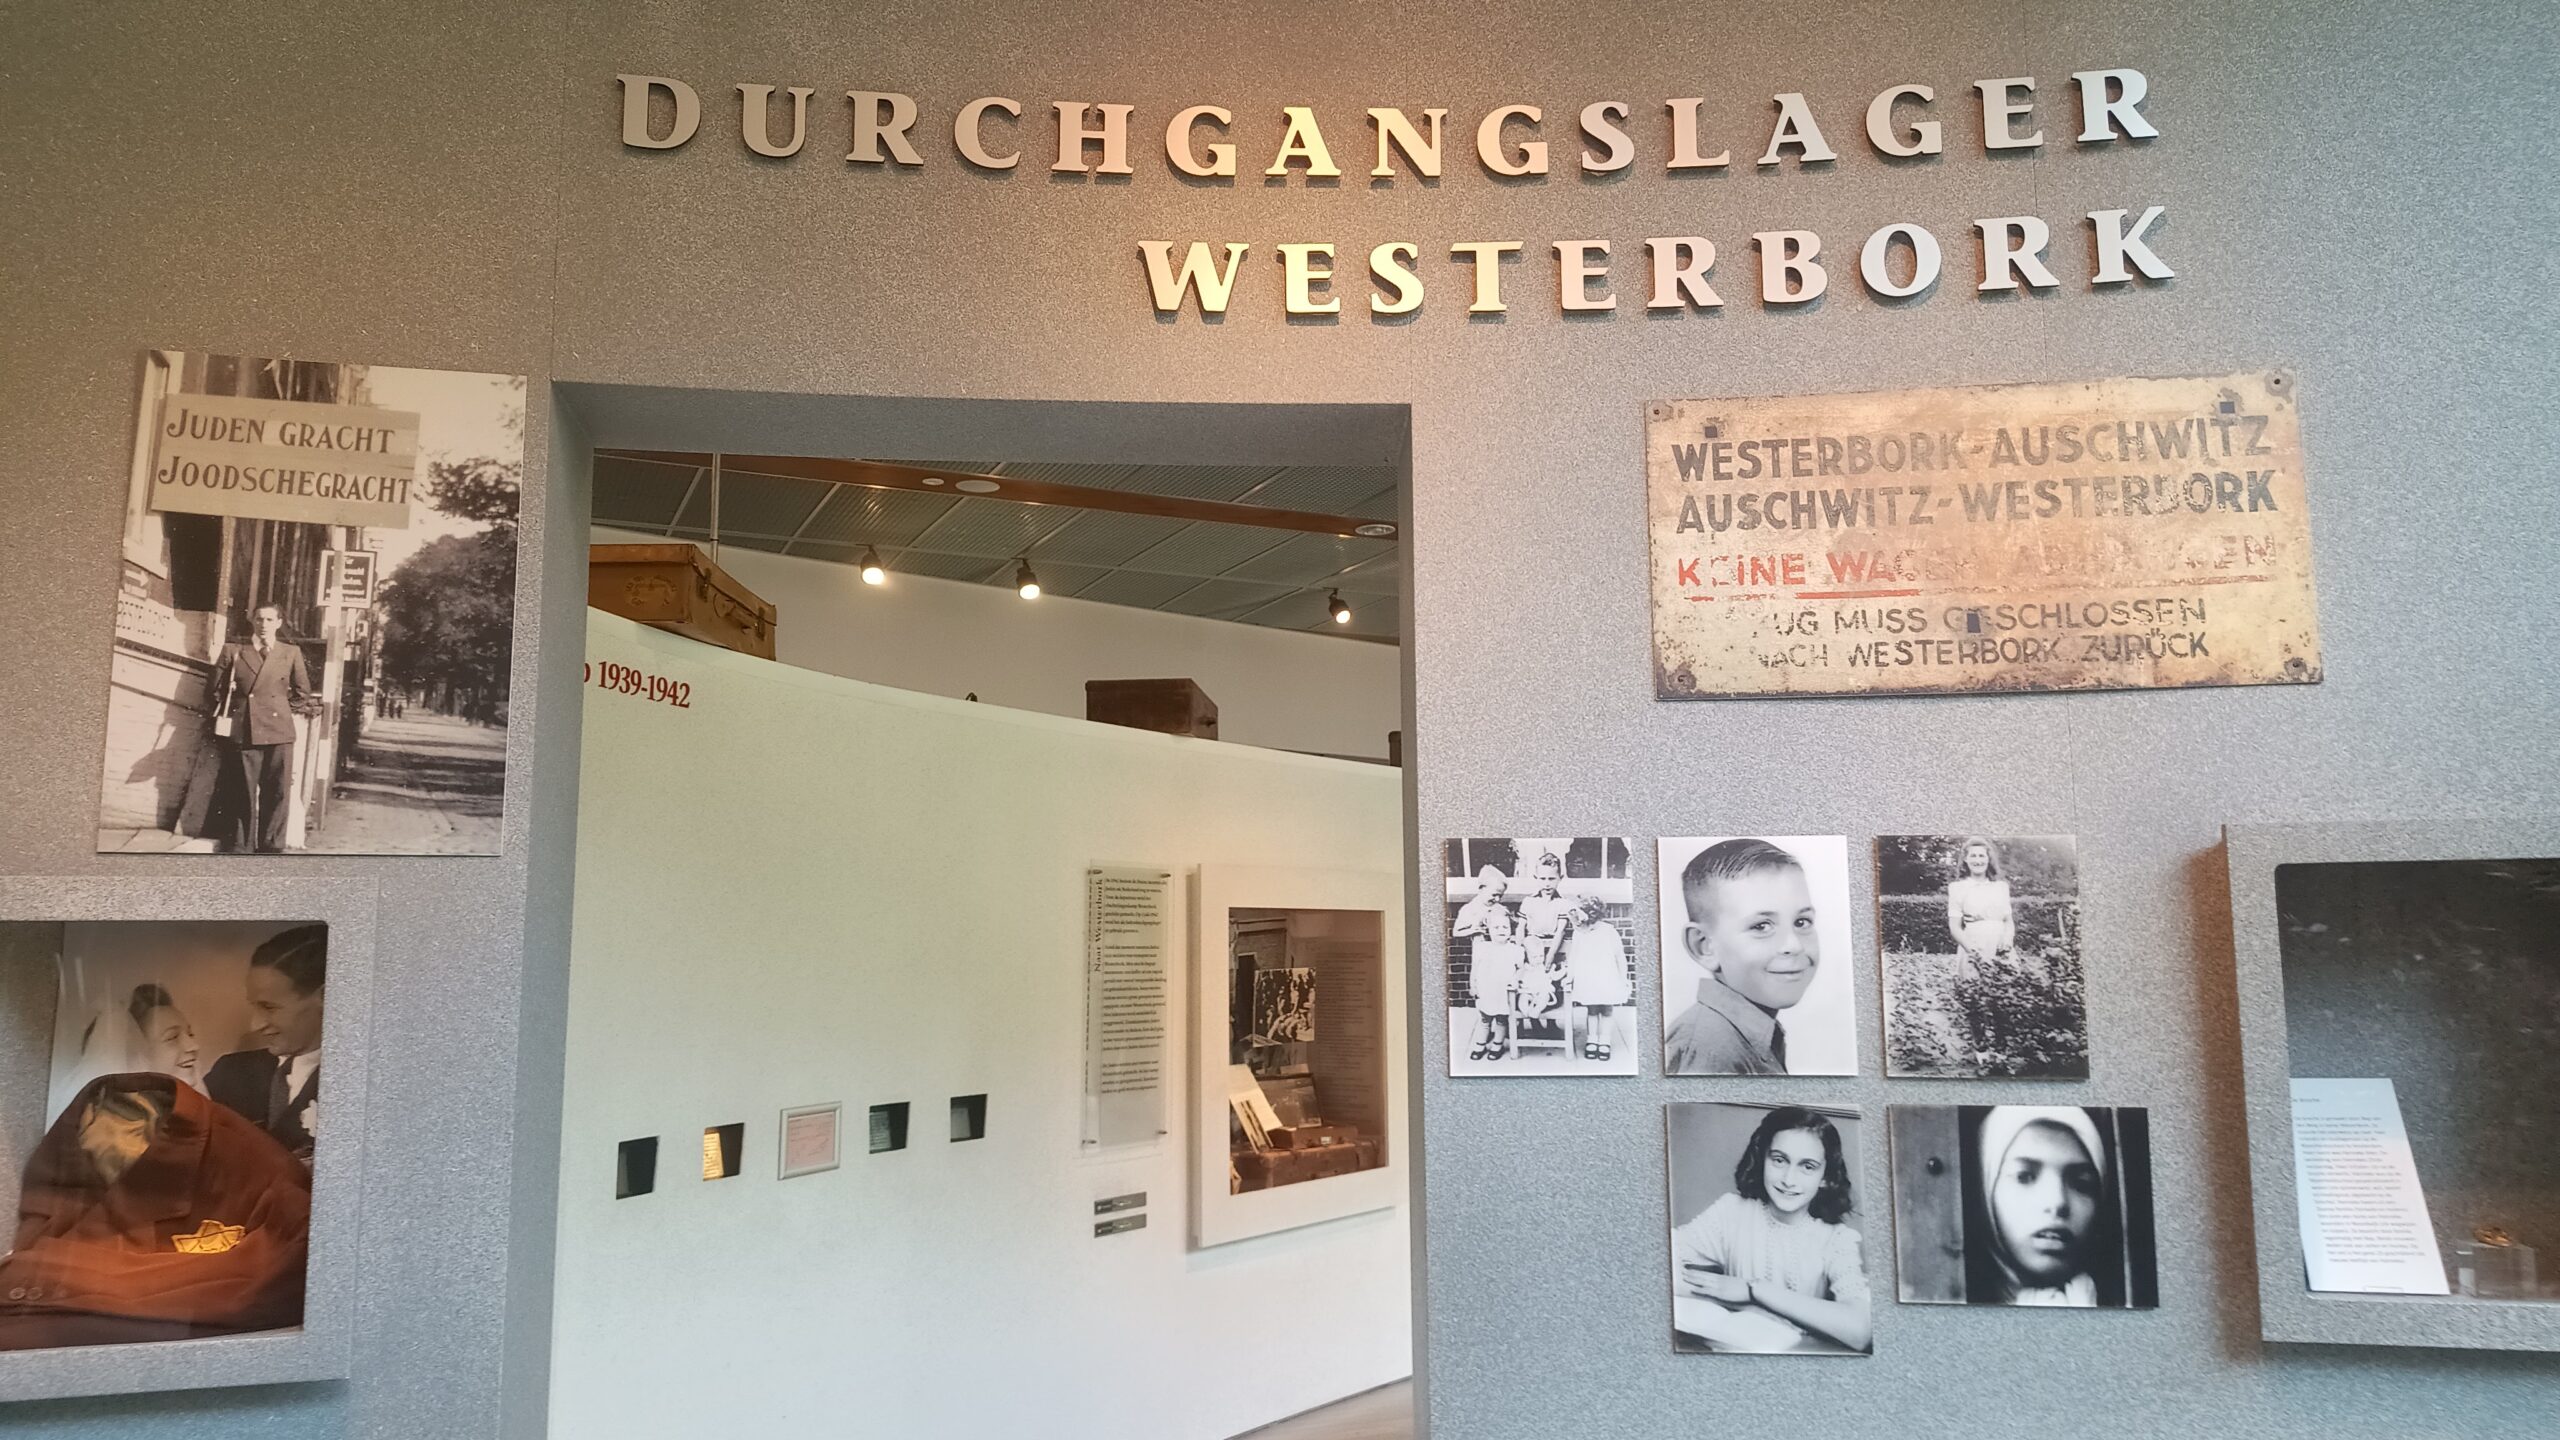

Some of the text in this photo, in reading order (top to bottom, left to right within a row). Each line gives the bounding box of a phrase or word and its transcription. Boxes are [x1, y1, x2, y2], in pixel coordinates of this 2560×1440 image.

[616, 67, 2158, 179] DURCHGANGSLAGER
[1137, 204, 2176, 318] WESTERBORK
[166, 407, 396, 454] JUDEN GRACHT
[1671, 415, 2273, 483] WESTERBORK-AUSCHWITZ
[158, 455, 413, 504] JOODSCHEGRACHT
[1757, 609, 1819, 636] UG
[1834, 607, 1928, 634] MUSS
[1848, 636, 2062, 668] WESTERBORK
[2080, 628, 2210, 663] ZURÜCK
[598, 661, 691, 708] 1939-1942
